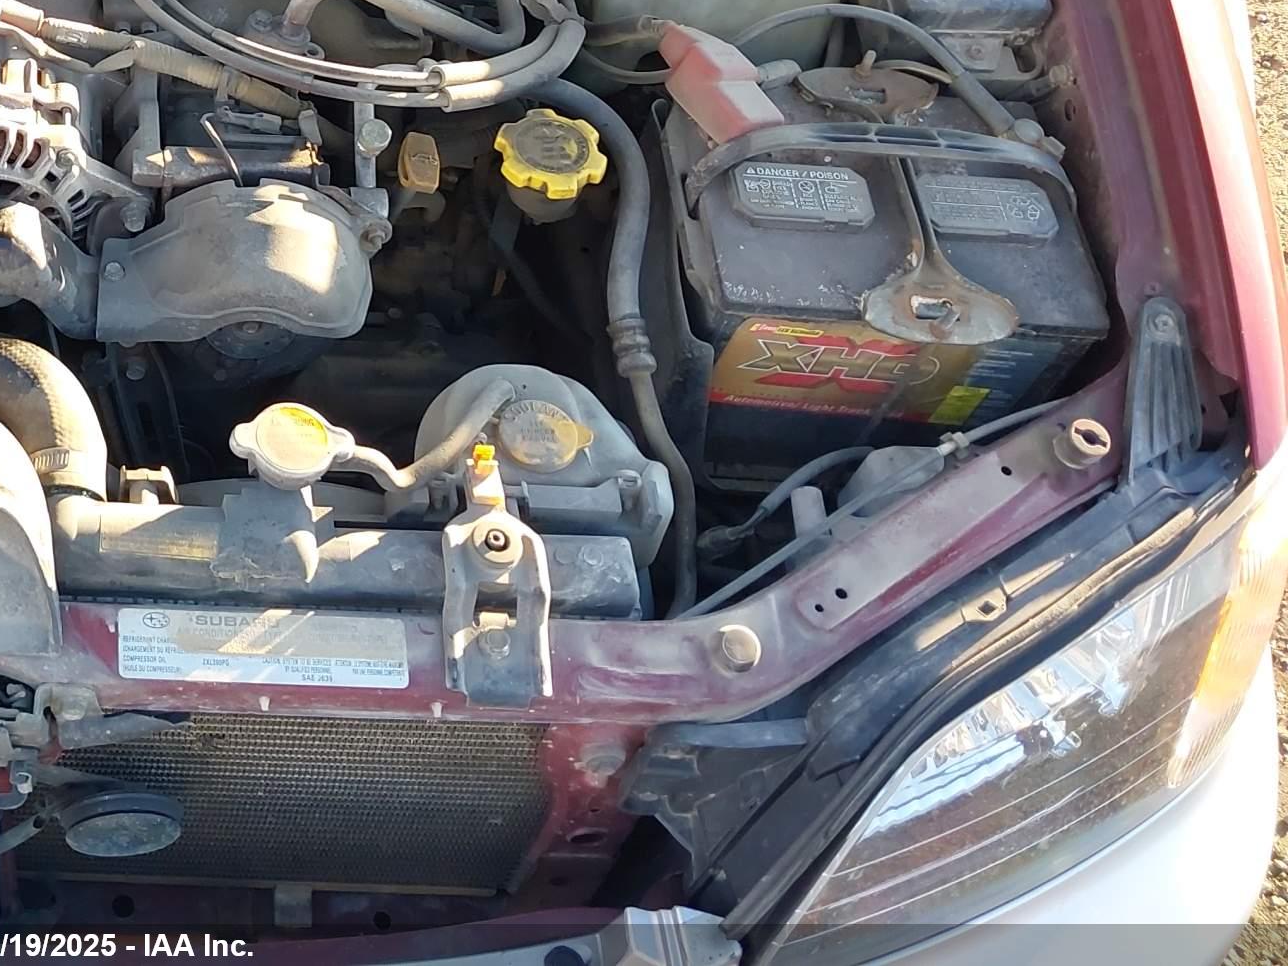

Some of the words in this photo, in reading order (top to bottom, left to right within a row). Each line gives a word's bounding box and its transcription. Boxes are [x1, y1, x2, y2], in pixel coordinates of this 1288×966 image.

[756, 167, 799, 178] DANGER
[810, 171, 849, 181] POISON
[122, 654, 157, 663] COMPRESSOR
[158, 656, 167, 664] OIL
[301, 673, 315, 682] SAE
